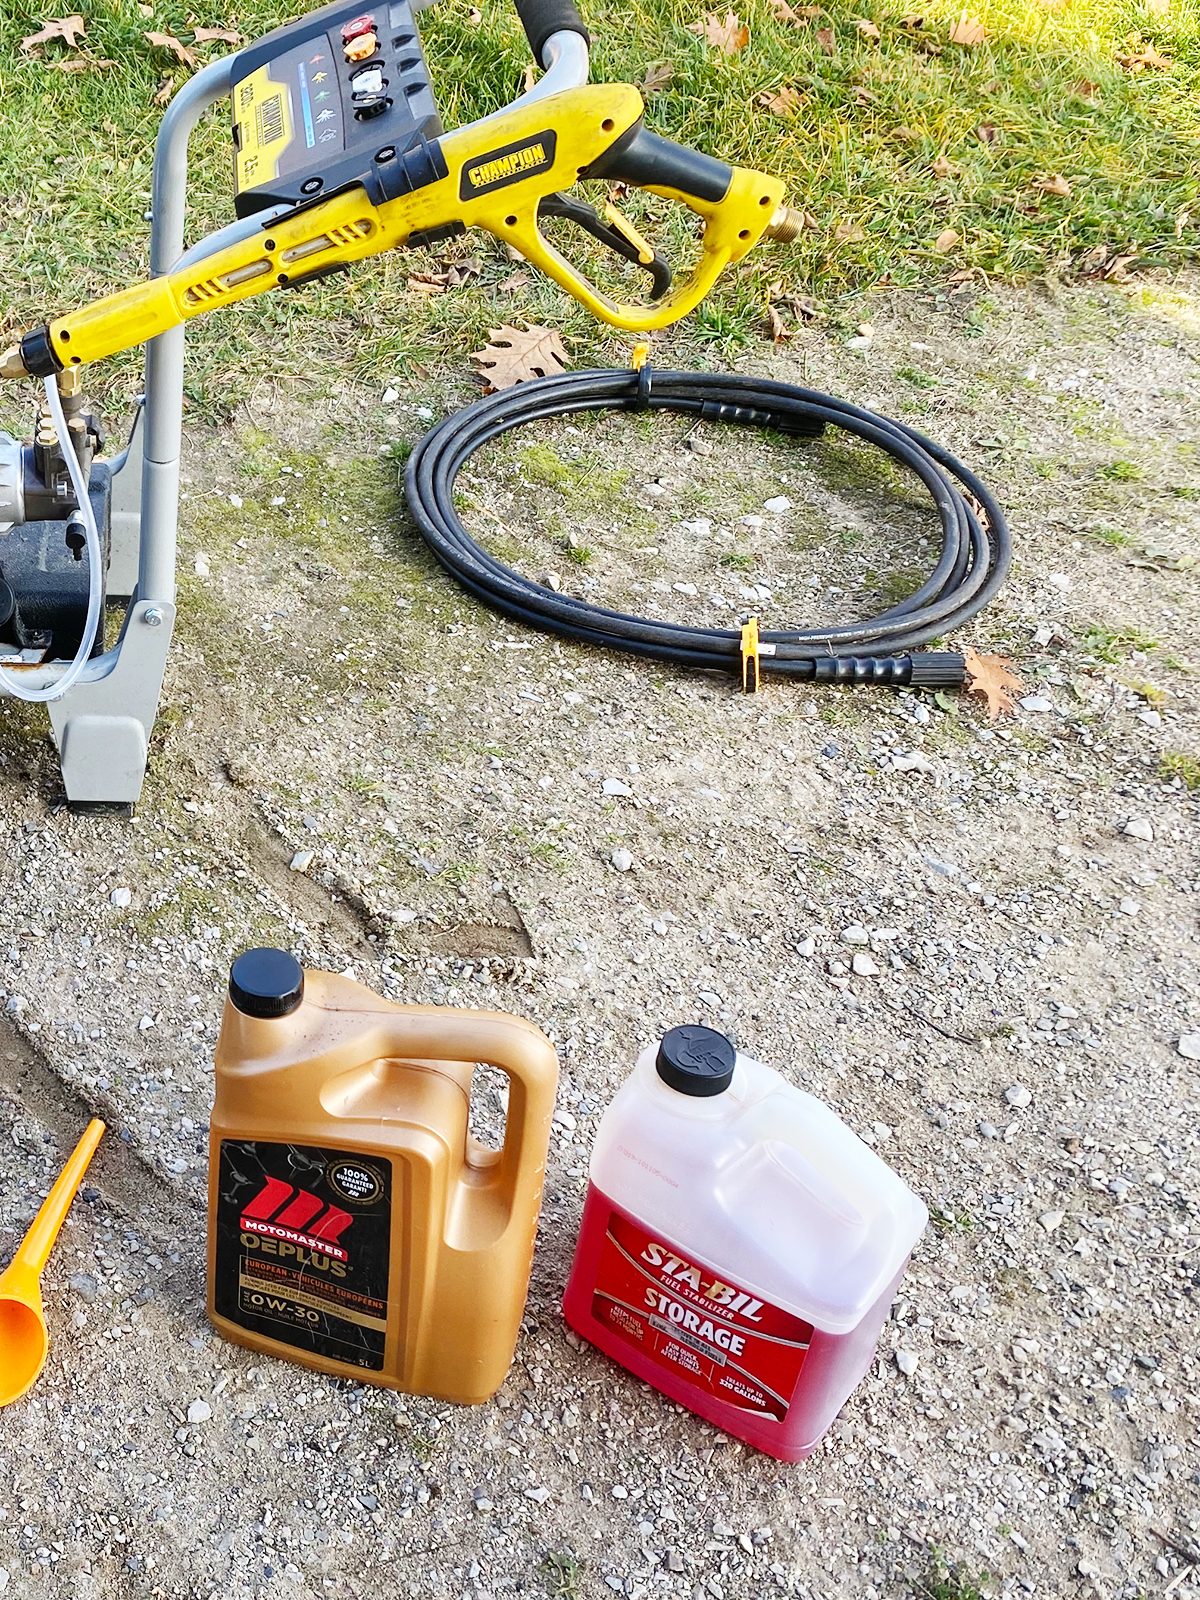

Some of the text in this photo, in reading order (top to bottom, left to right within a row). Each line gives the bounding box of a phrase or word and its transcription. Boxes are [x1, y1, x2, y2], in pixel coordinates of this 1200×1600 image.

[261, 93, 283, 145] CHAMPION
[469, 143, 546, 186] CHAMPION
[336, 1173, 374, 1190] GUARANTEED
[341, 1180, 367, 1193] GARANTI
[343, 1167, 368, 1181] 100%
[240, 1233, 347, 1278] OEPLUS
[245, 1220, 343, 1258] MOTOMASTER
[245, 1260, 287, 1277] EUROPEAN
[640, 1243, 765, 1322] STA-BIL
[250, 1294, 320, 1322] 0W-30
[660, 1274, 735, 1320] FUEL STABILIZER
[644, 1287, 746, 1356] STORAGE
[733, 1386, 767, 1407] GALLONS
[746, 1385, 755, 1394] UP
[755, 1390, 763, 1398] TO
